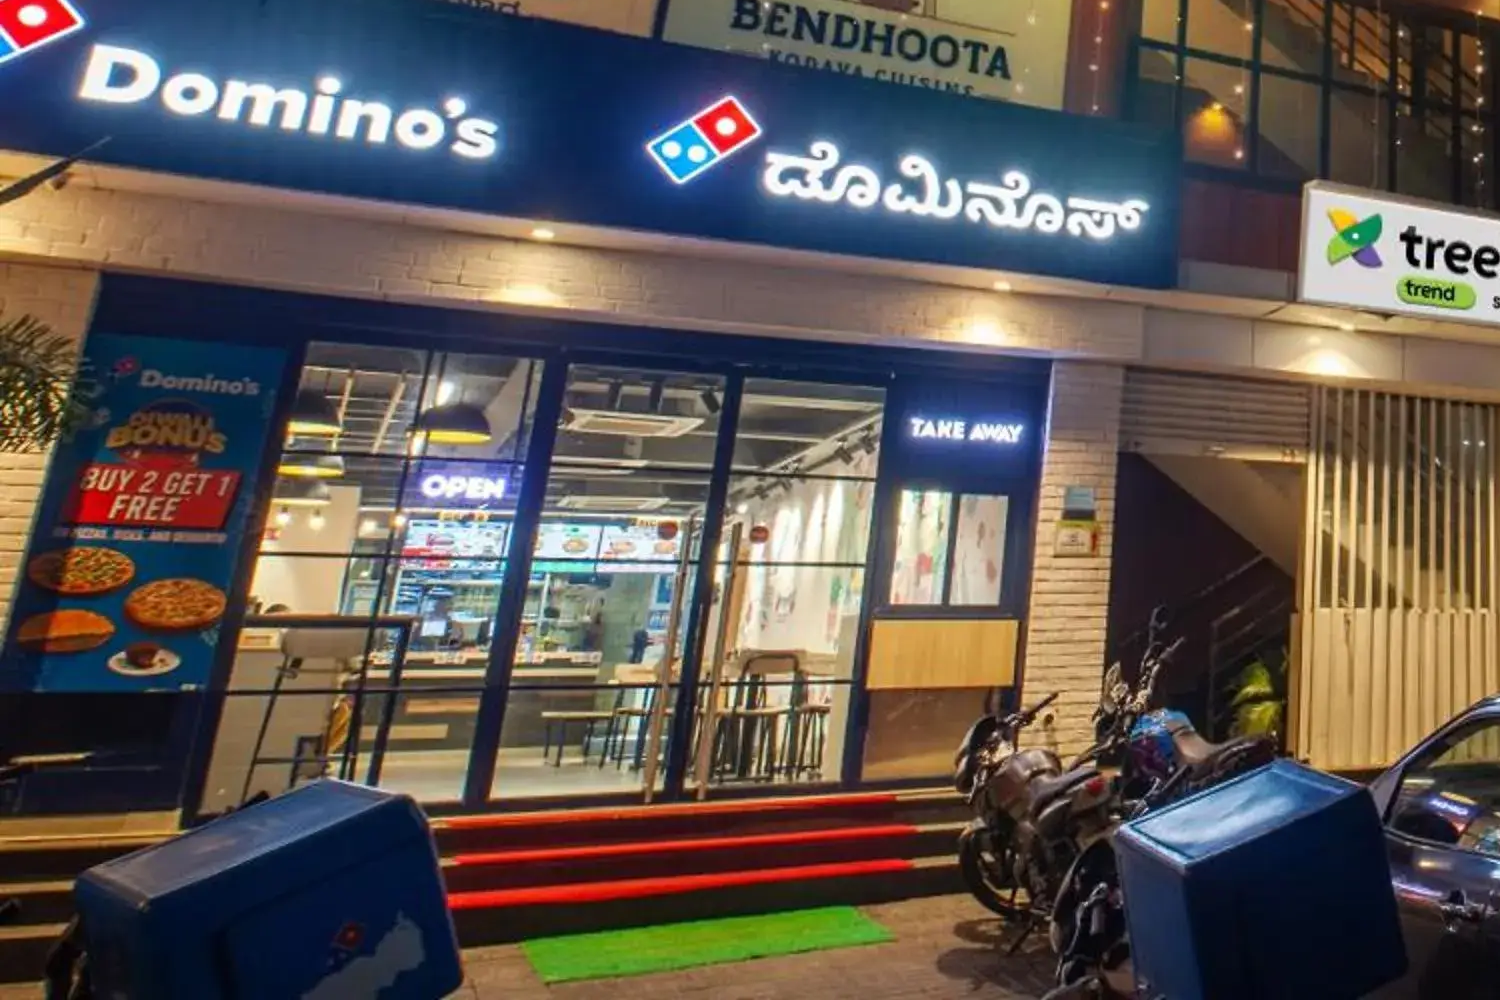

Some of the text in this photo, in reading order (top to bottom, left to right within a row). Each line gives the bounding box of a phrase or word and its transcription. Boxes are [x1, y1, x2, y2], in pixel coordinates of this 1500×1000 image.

[78, 43, 499, 160] Domino's
[1405, 279, 1456, 302] trend
[140, 369, 260, 396] Domino's
[105, 424, 228, 454] BONUS
[910, 417, 1024, 443] TAKE AWAY
[82, 466, 231, 497] BUY 2 GET 1
[421, 474, 506, 498] OPEN
